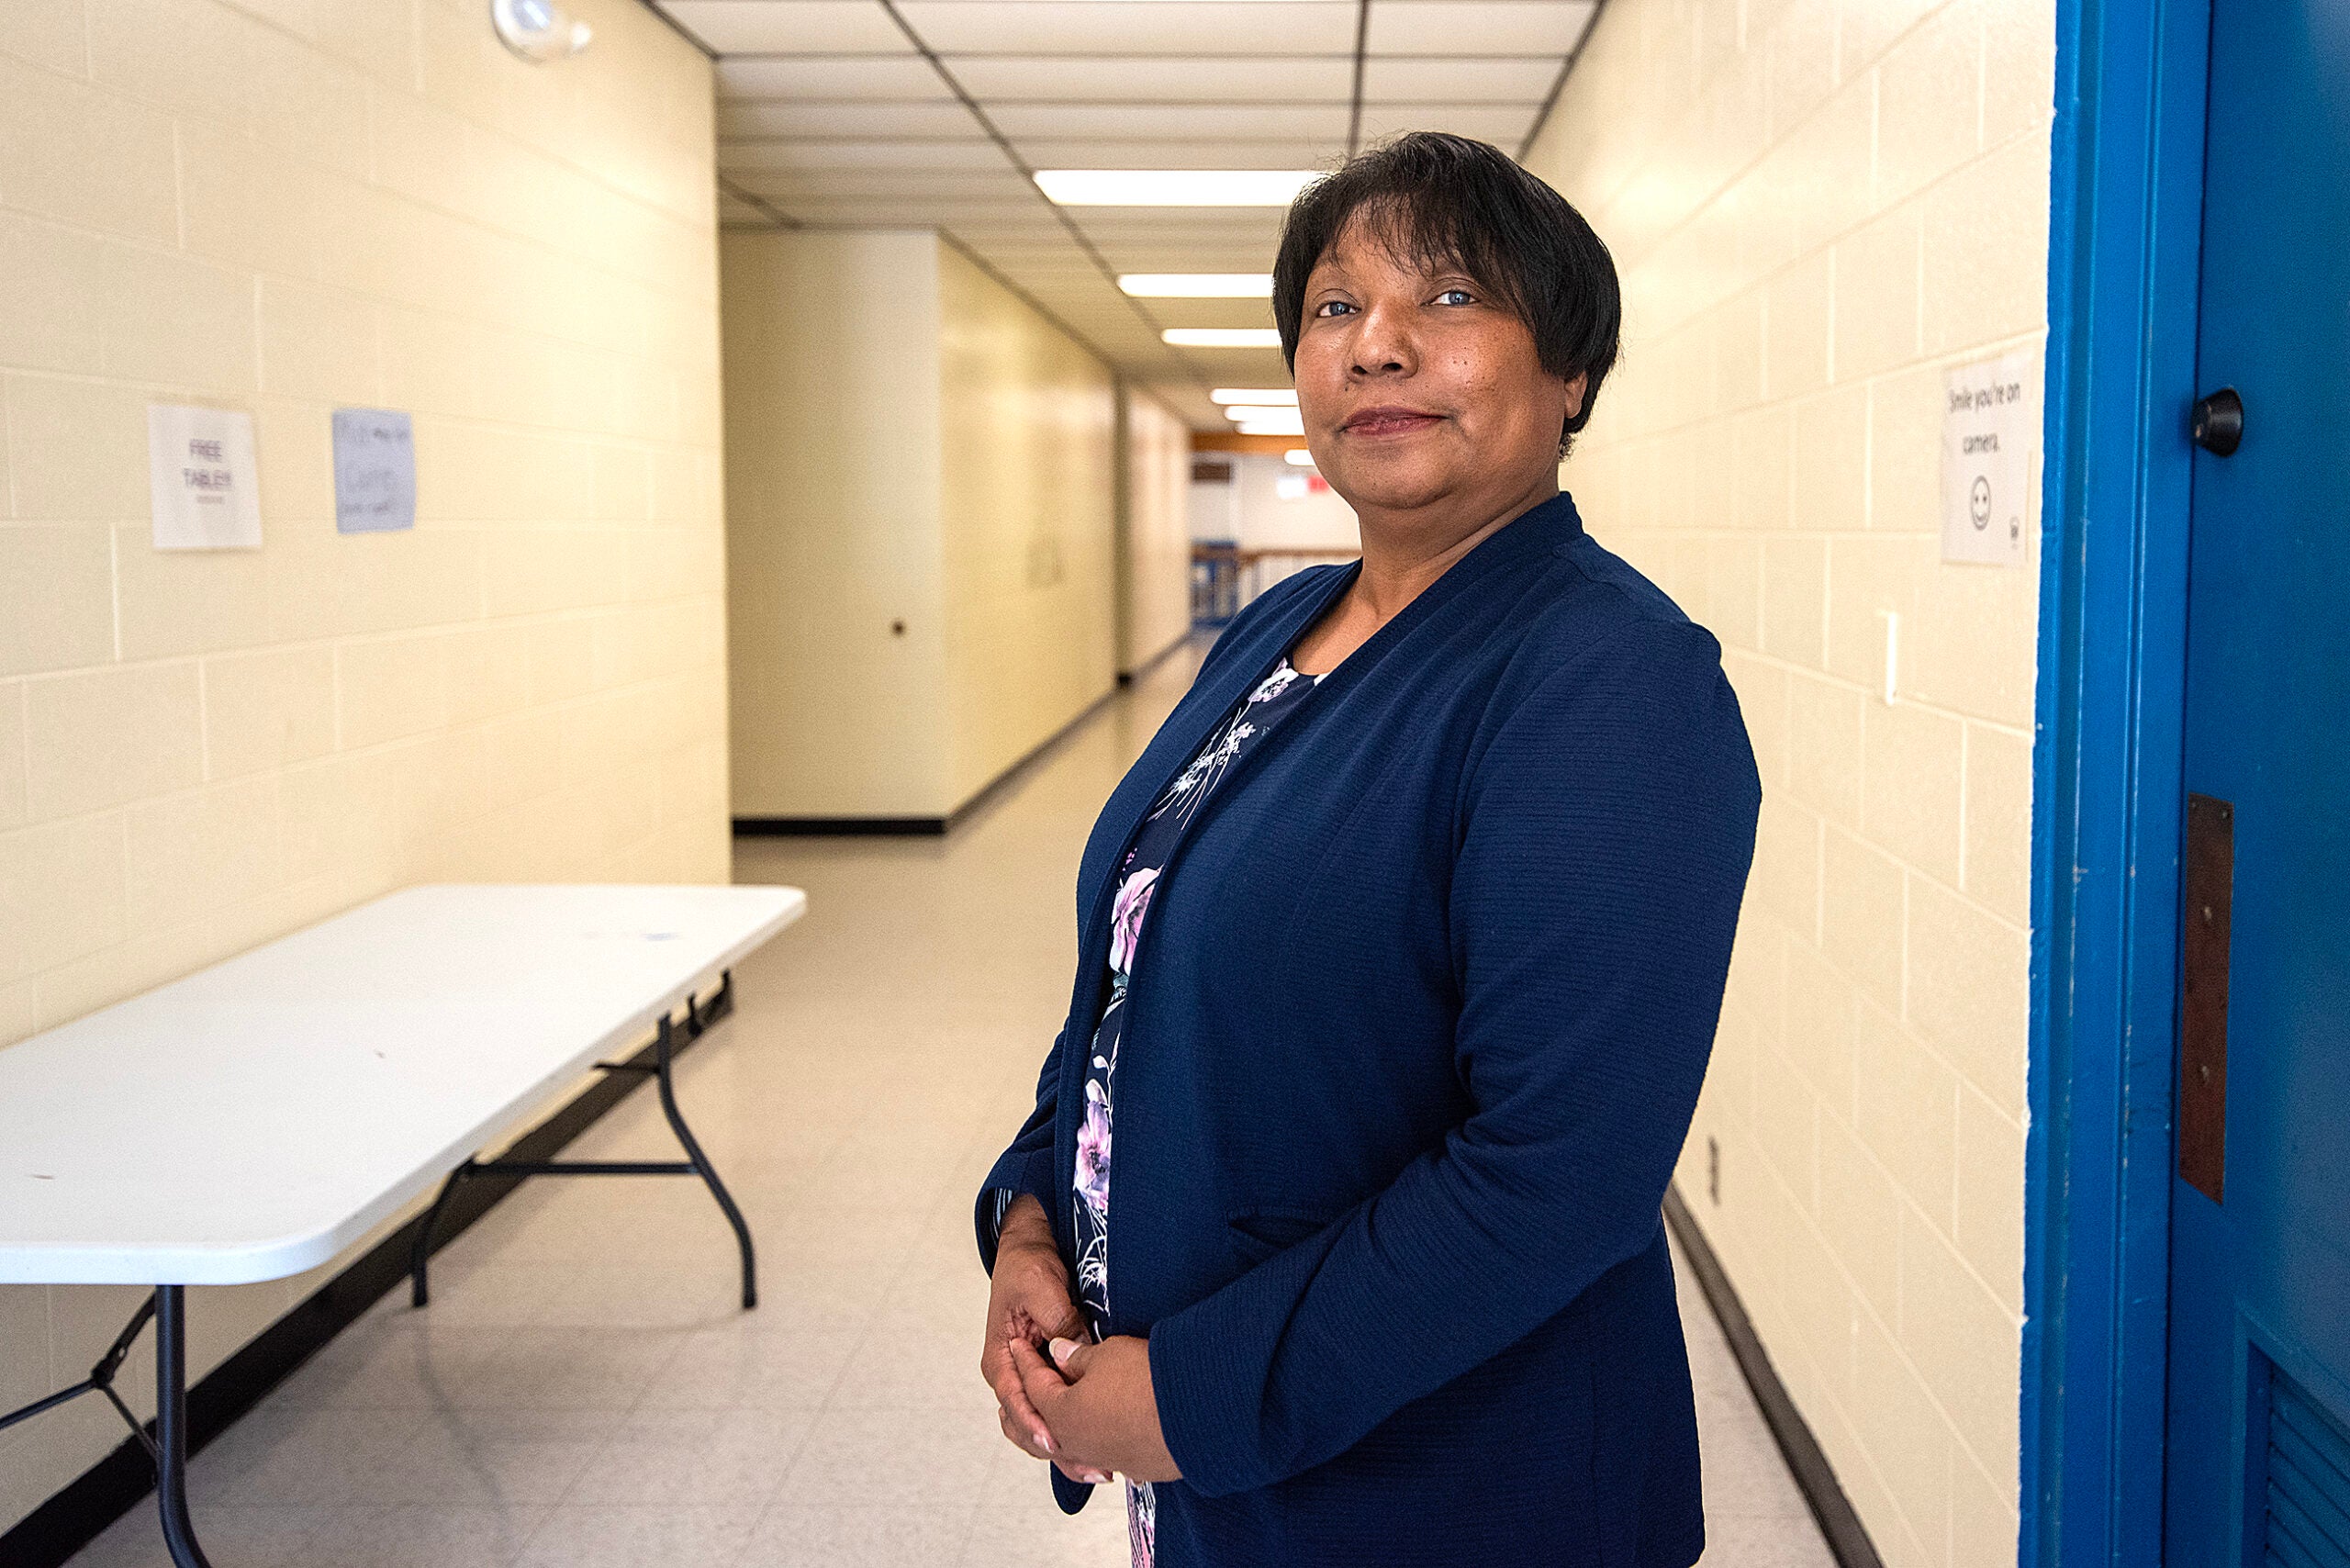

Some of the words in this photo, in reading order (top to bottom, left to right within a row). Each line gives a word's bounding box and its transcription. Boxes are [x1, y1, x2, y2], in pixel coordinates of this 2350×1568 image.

[1949, 387, 1972, 413] Smile
[1975, 381, 2004, 412] you're
[2007, 382, 2020, 405] on
[190, 439, 222, 460] FREE
